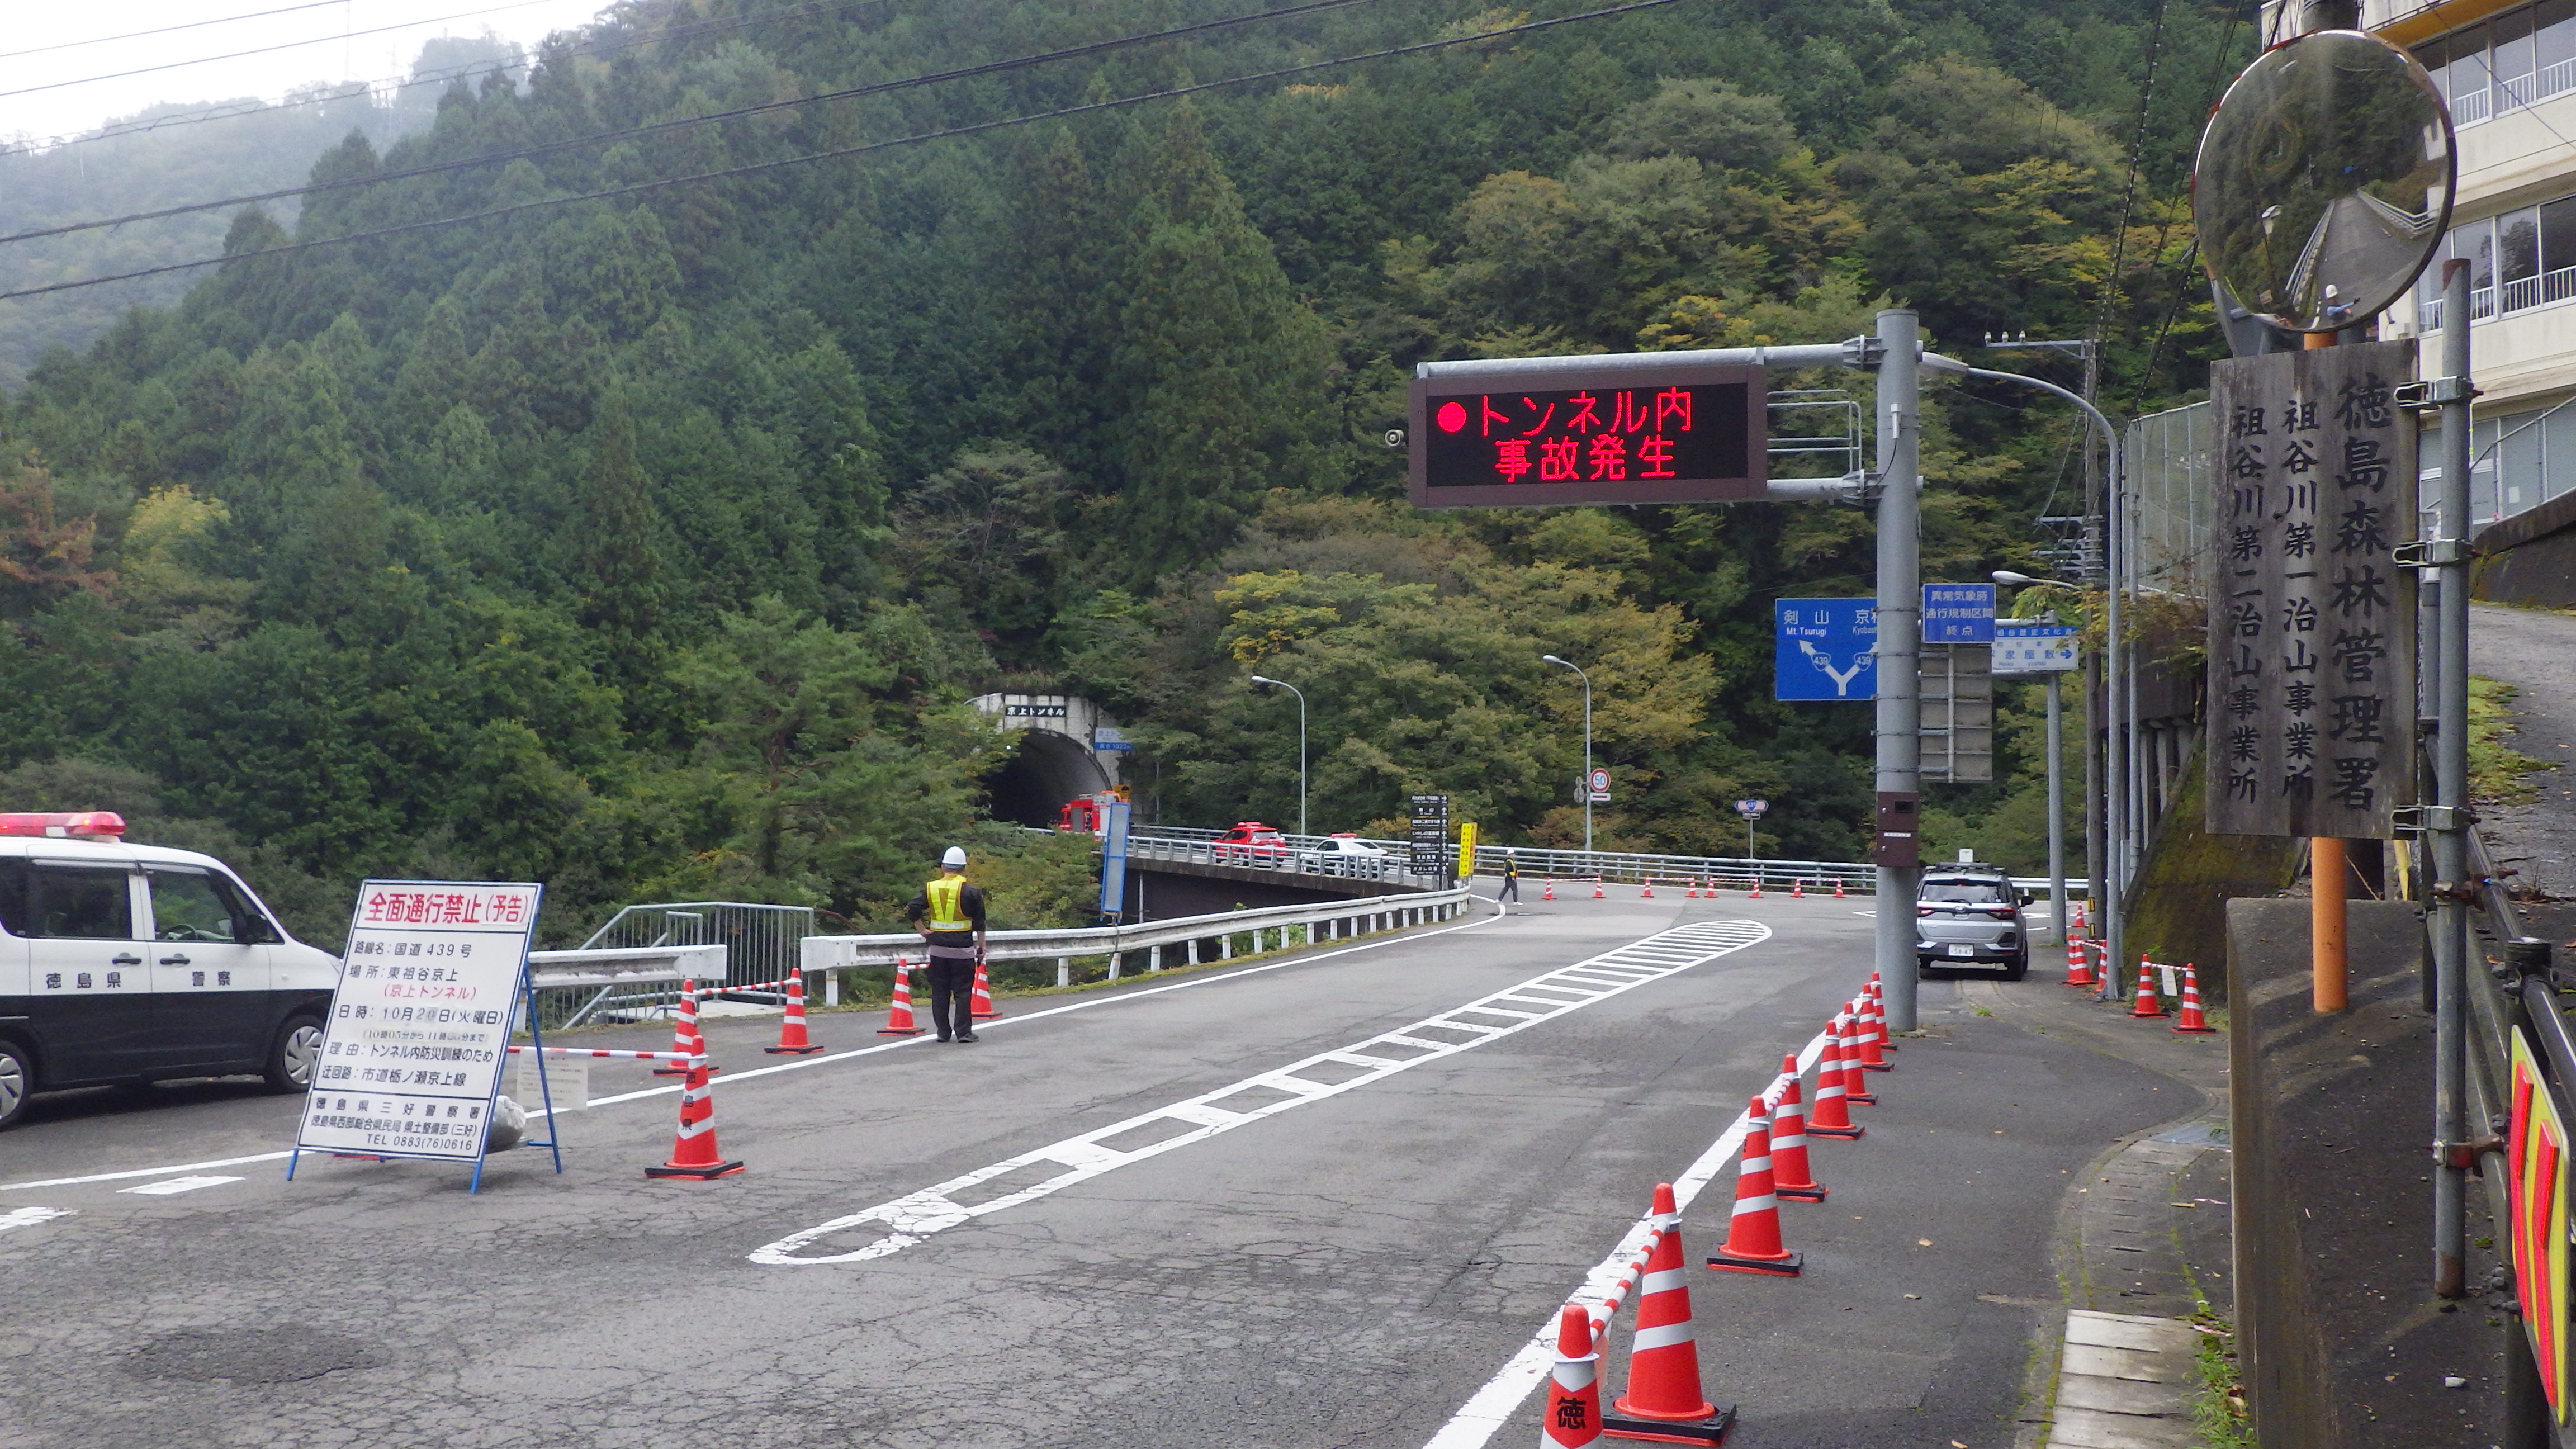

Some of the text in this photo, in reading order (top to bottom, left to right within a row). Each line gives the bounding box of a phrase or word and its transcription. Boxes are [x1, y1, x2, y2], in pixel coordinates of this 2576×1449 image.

[1483, 386, 1693, 438] トンネル内
[1494, 433, 1676, 483] 事故発生
[1931, 590, 1988, 602] 異常気象時
[2330, 373, 2393, 812] 徳島森林管理署
[2227, 405, 2267, 805] 祖谷川第二治山事業所
[2281, 400, 2320, 802] 祖谷川第一治山事業所
[1925, 608, 1993, 619] 通行規制区間
[1786, 627, 1827, 637] Mt. Tsurugi
[1945, 625, 1973, 636] 終点
[1813, 655, 1829, 666] 439
[1856, 655, 1871, 666] 439
[1007, 706, 1065, 716] 京上トンネル
[1594, 775, 1606, 786] 50
[46, 972, 121, 989] 徳島県
[192, 970, 231, 987] 警察
[383, 983, 477, 1001] (京上トンネル)
[367, 1134, 387, 1145] TEL
[1556, 1396, 1587, 1429] 徳
